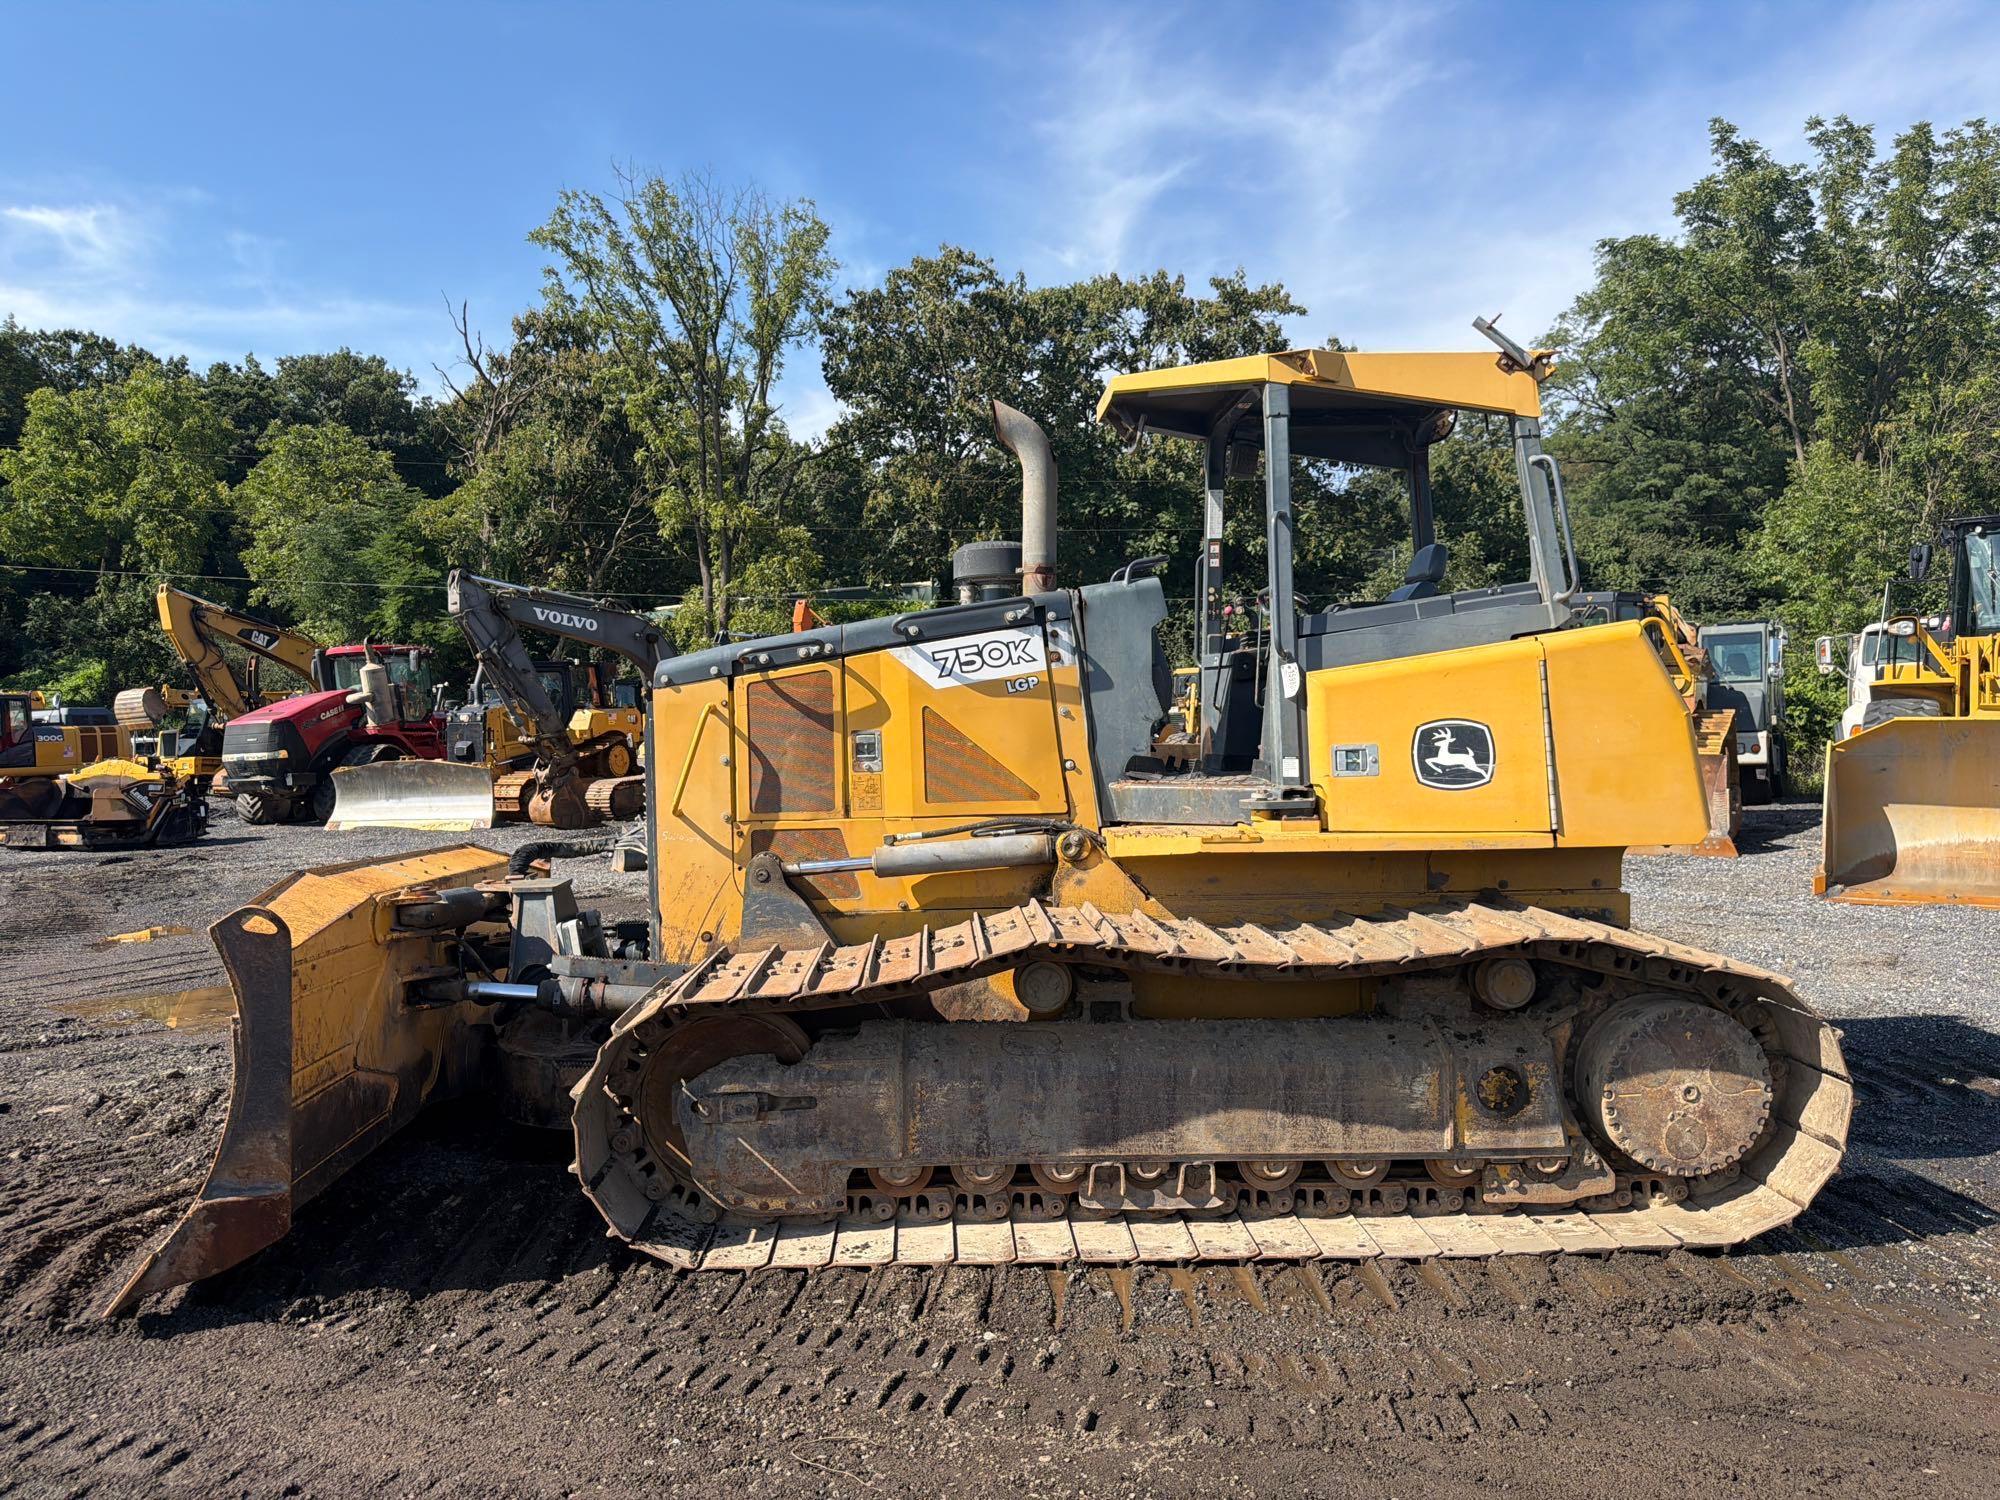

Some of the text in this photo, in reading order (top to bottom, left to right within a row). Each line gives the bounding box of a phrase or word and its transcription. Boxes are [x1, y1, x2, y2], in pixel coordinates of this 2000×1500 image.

[533, 607, 598, 631] VOLVO
[251, 630, 270, 647] CAT
[931, 638, 1039, 678] 750K
[1005, 675, 1040, 694] LGP
[37, 734, 64, 742] 300G
[130, 787, 153, 810] LeeBoy
